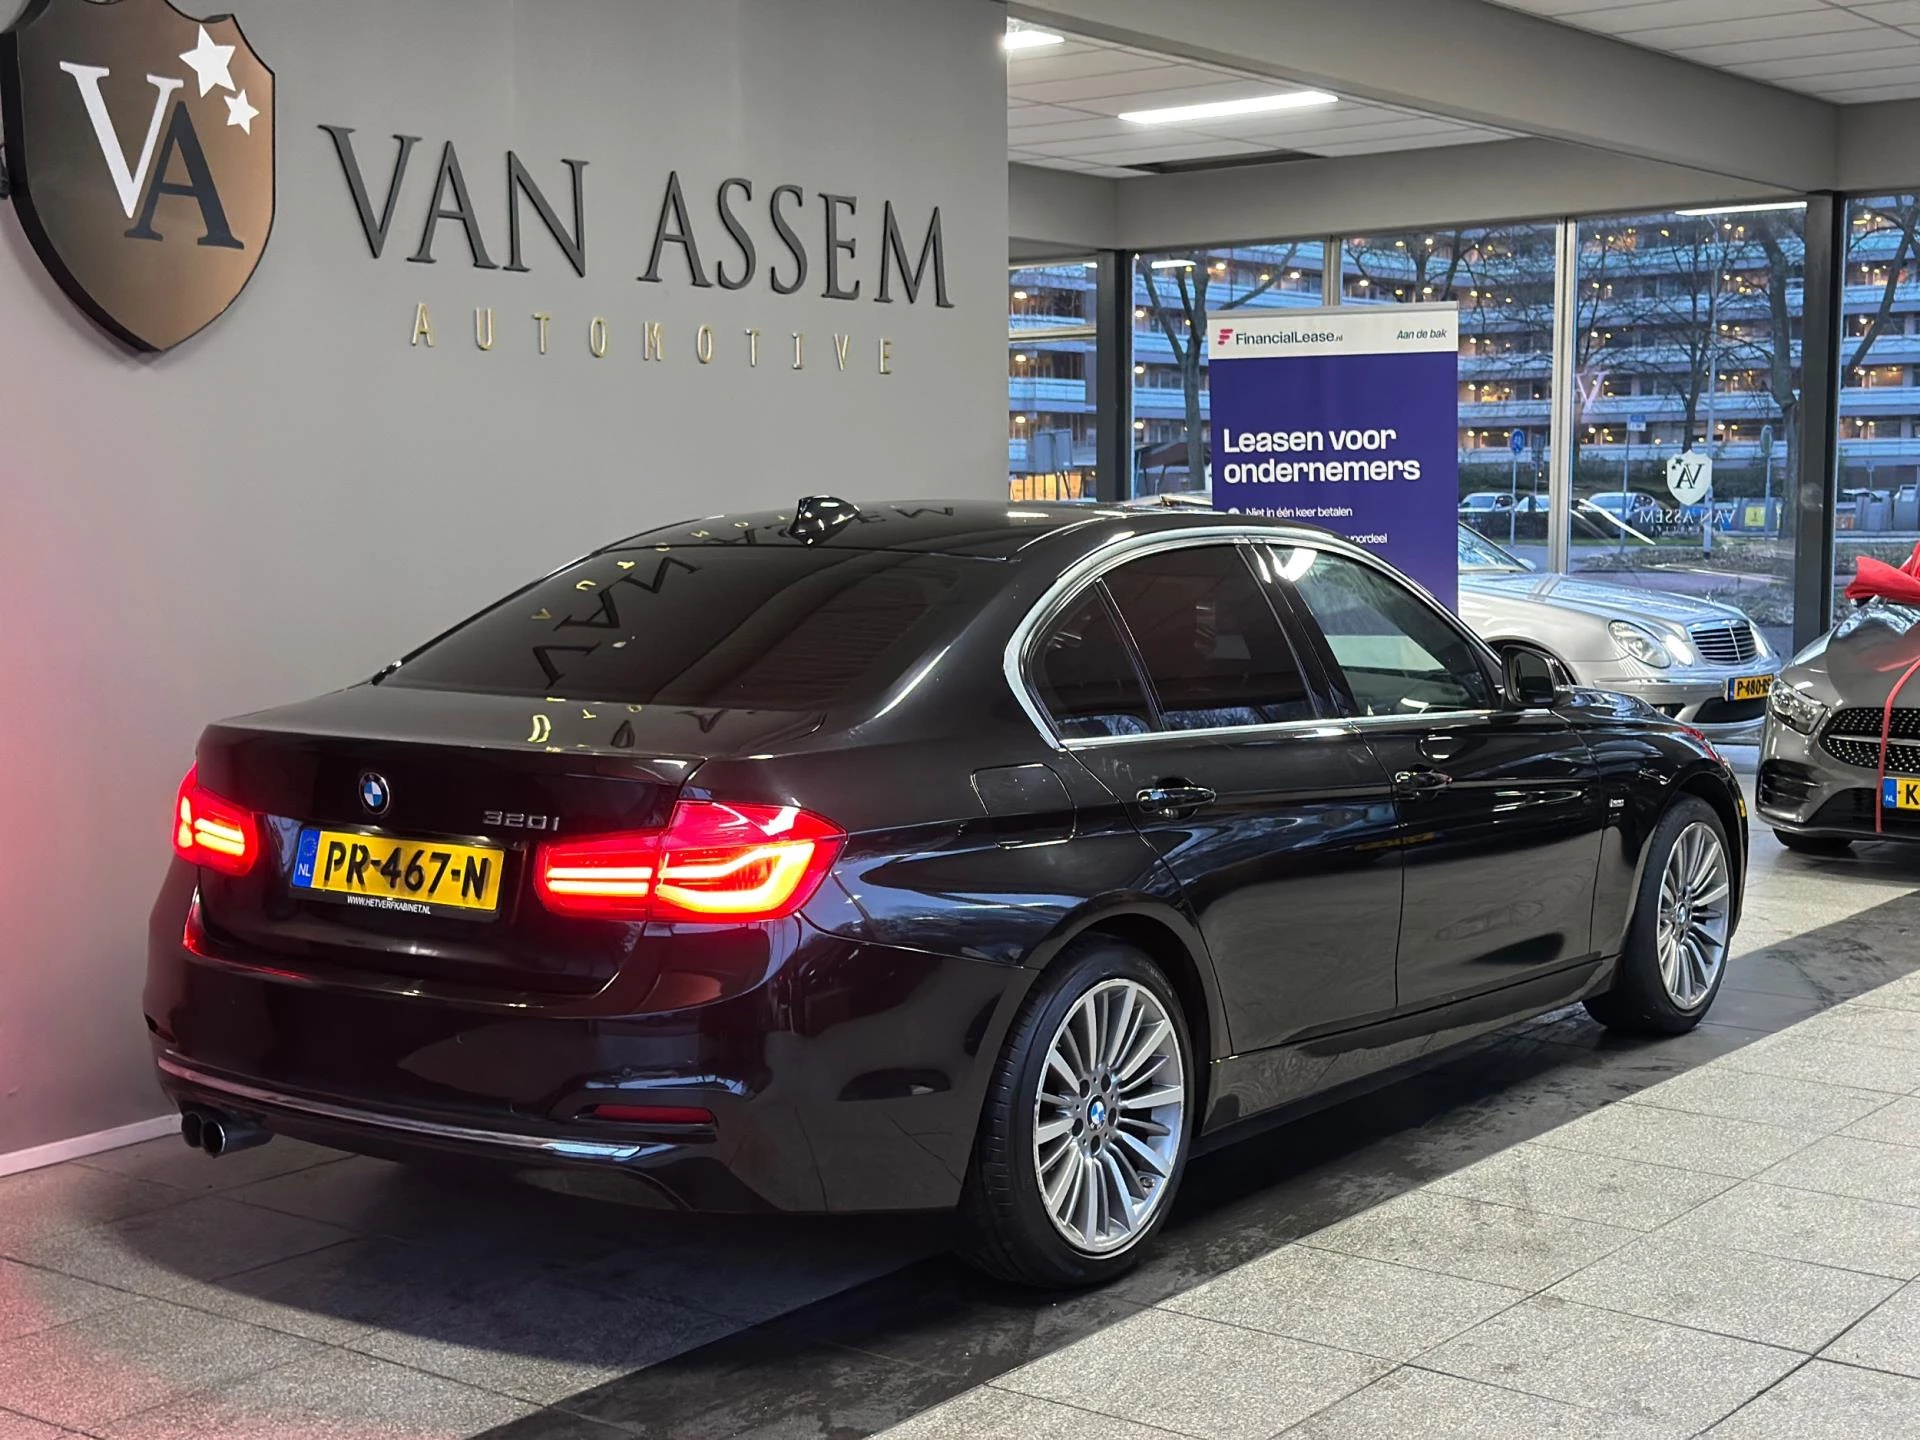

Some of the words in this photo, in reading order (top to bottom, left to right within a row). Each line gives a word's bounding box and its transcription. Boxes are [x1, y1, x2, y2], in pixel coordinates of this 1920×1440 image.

[60, 61, 245, 250] VA
[318, 124, 588, 278] VAN
[636, 170, 955, 309] ASSEM
[411, 302, 894, 376] AUTOMOTIVE
[1235, 331, 1343, 345] FinancialLease.nl
[1396, 330, 1414, 340] Aan
[1416, 329, 1428, 339] de
[1430, 328, 1448, 339] bak
[1223, 428, 1324, 453] Leasen
[1329, 429, 1397, 451] voor
[1223, 458, 1421, 484] ondernemers
[1266, 506, 1275, 518] in
[1276, 506, 1295, 518] één
[1296, 506, 1315, 517] keer
[1317, 506, 1353, 517] betalen
[1885, 794, 1896, 803] NL
[298, 864, 311, 878] NL
[324, 841, 489, 900] PR-467-N
[347, 895, 431, 915] WWW.HETVERFKABINET.NL
